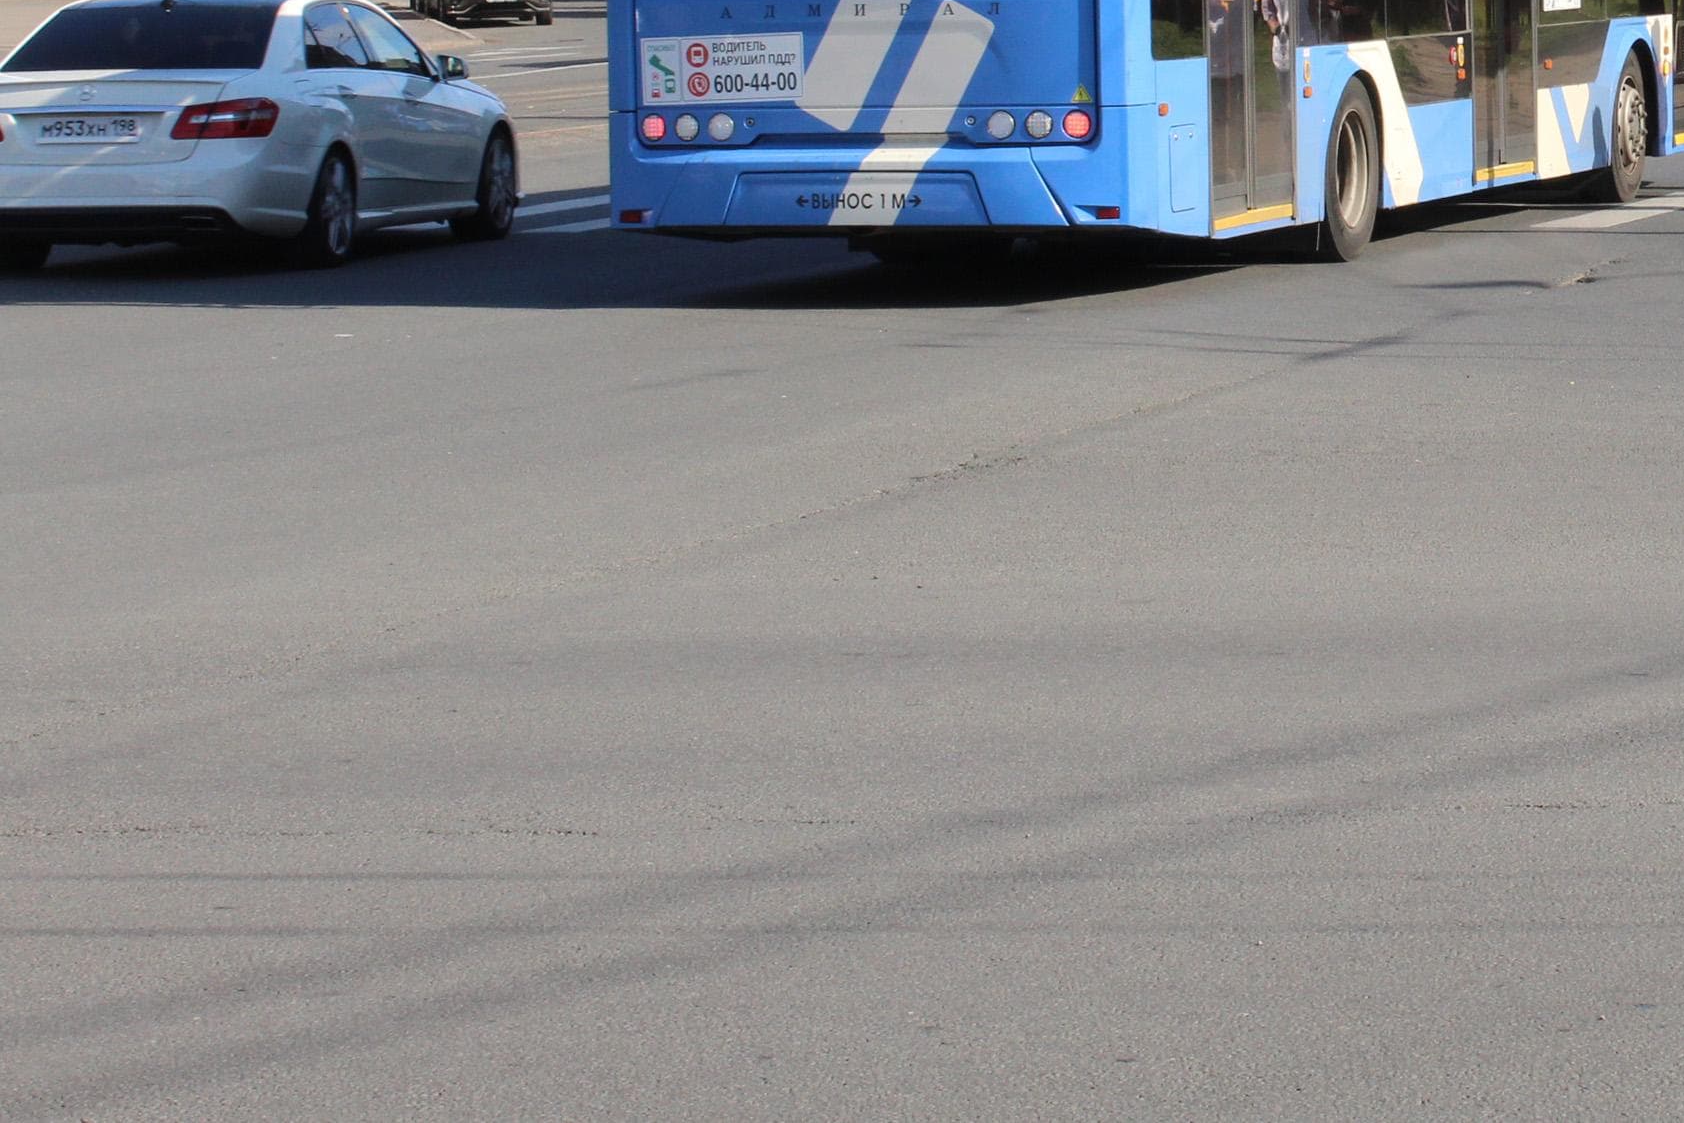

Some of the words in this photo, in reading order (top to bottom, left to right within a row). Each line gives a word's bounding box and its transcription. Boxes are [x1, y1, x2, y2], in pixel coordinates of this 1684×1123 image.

[720, 2, 1000, 19] АДМИРАЛ
[712, 41, 766, 54] ВОДИТЕЛЬ
[713, 55, 765, 66] НАРУШИЛ
[768, 53, 796, 66] ПДД?
[714, 72, 797, 94] 600-44-00
[811, 193, 873, 209] ВЫНОС
[881, 193, 885, 208] 1
[892, 193, 905, 209] М
